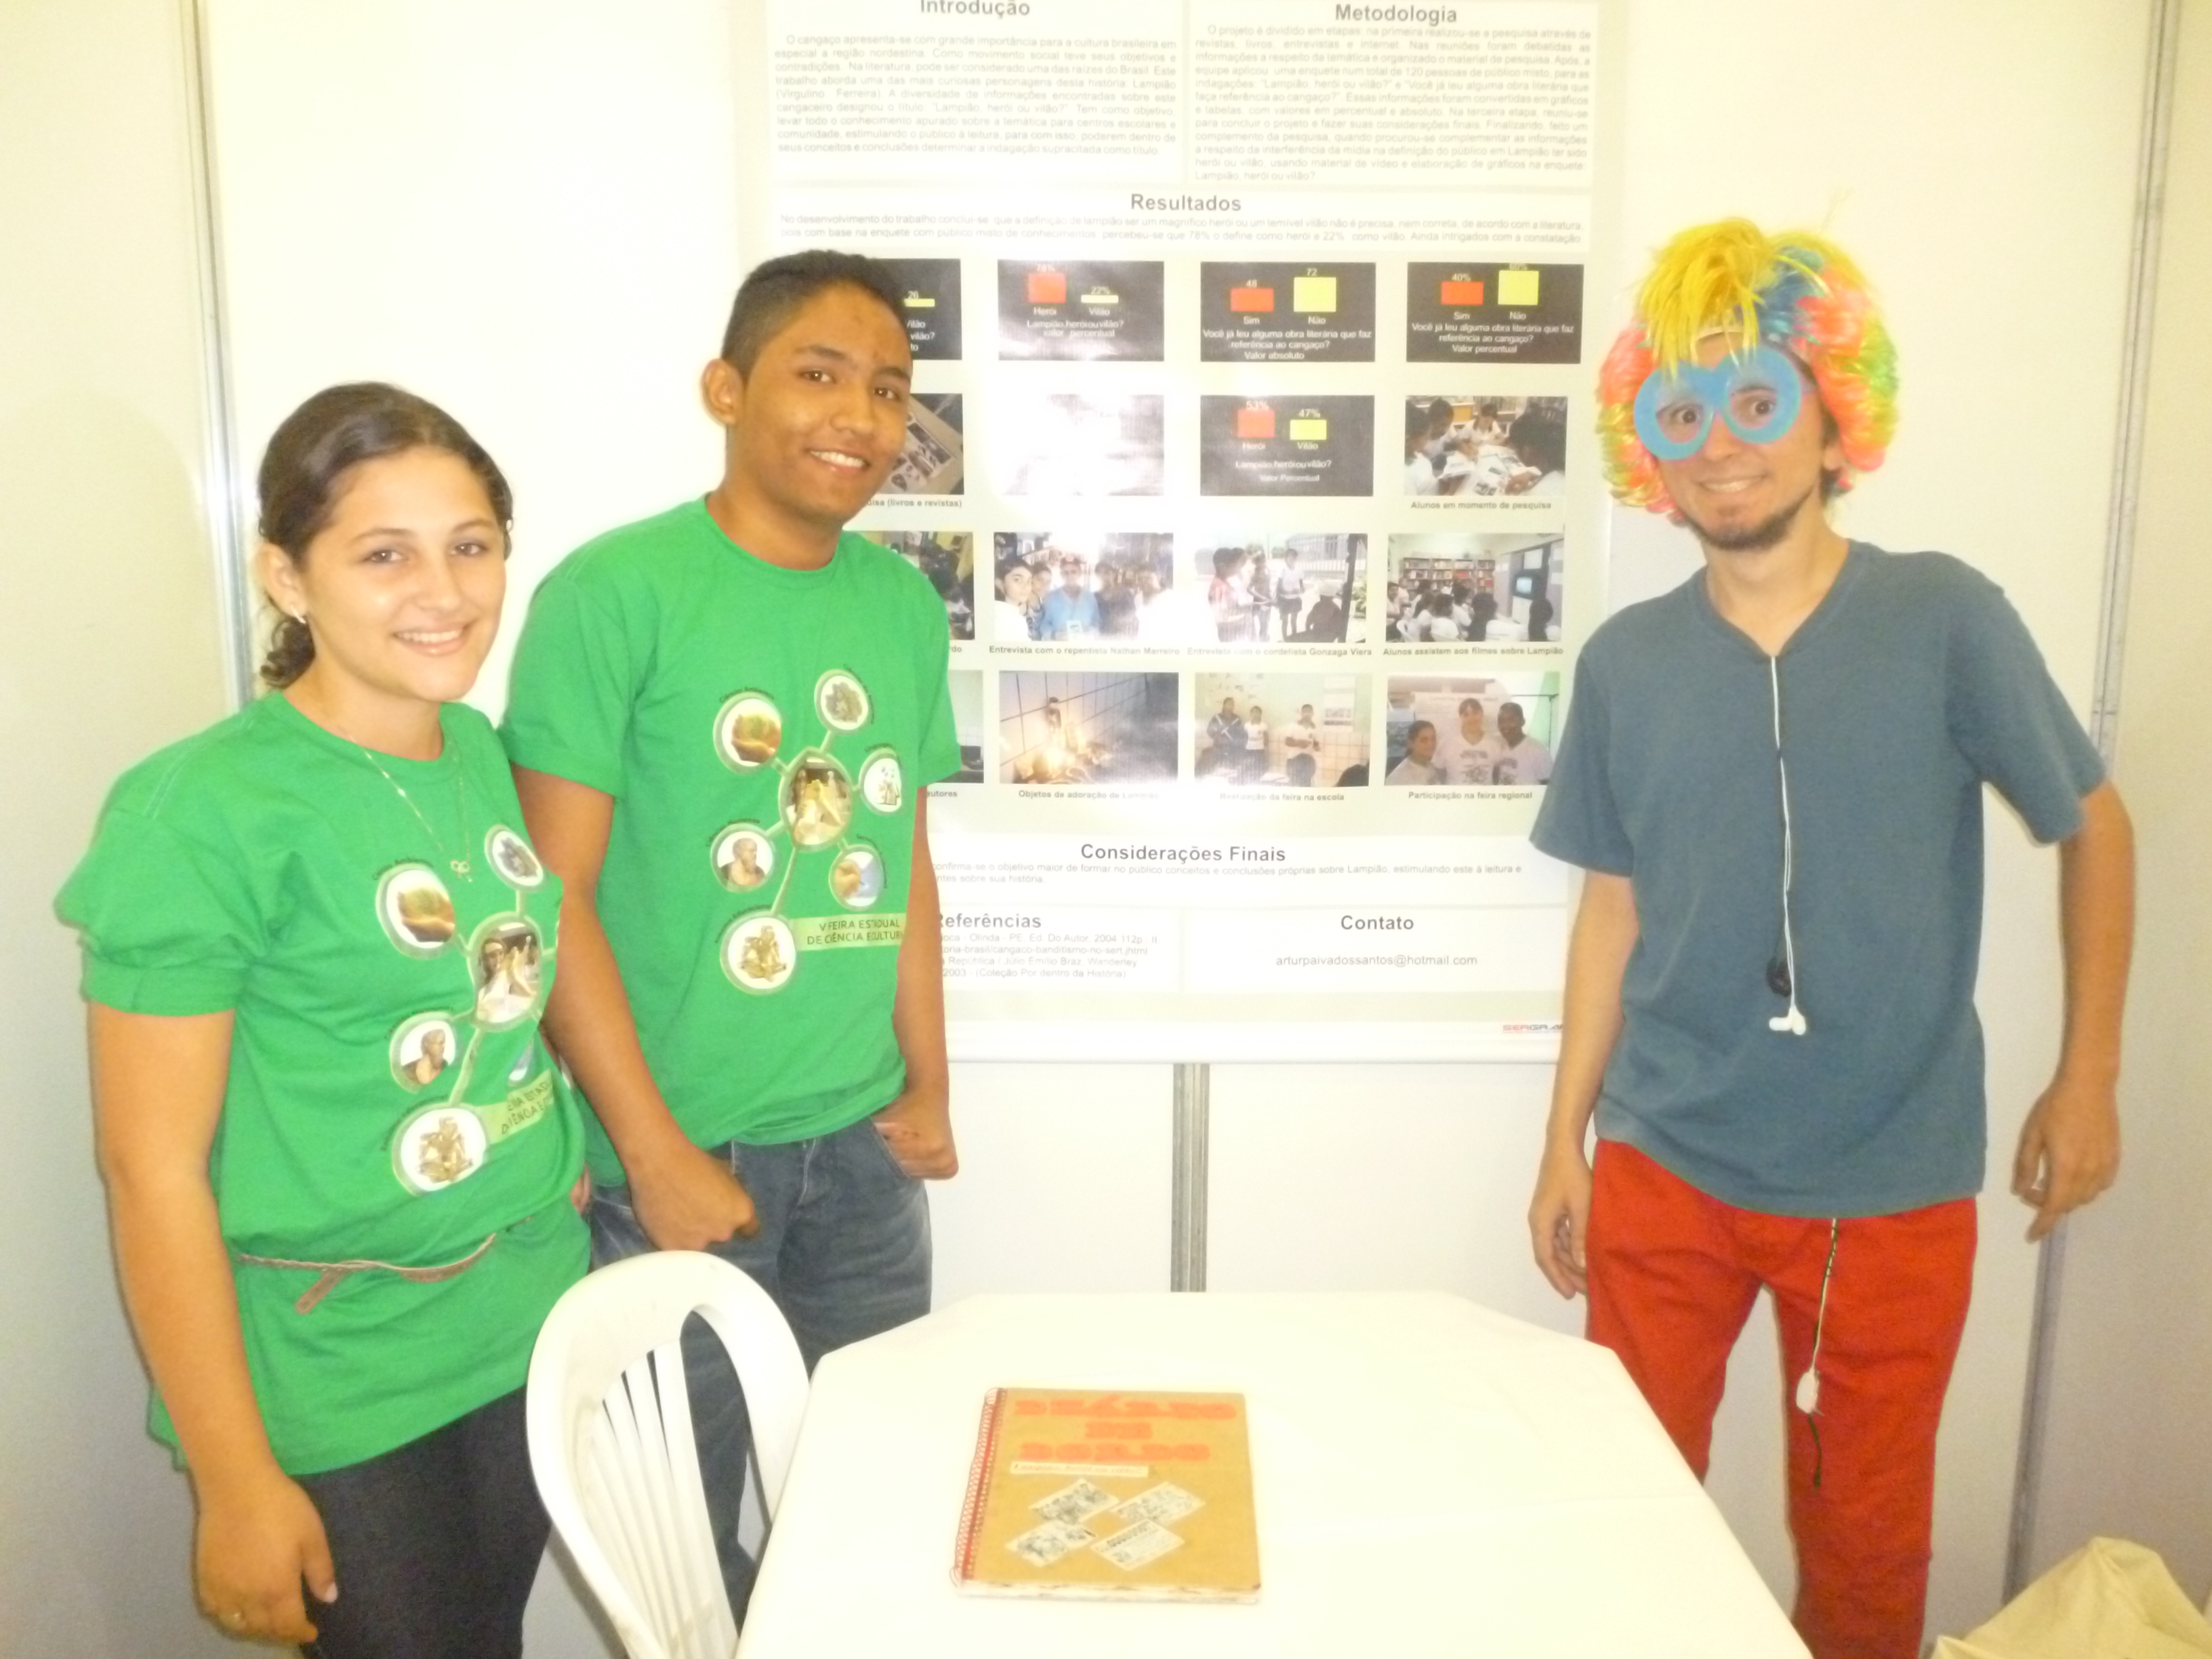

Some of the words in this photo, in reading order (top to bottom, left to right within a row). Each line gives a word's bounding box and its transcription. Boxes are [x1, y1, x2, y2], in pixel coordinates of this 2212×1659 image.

[920, 0, 1030, 19] Introdução
[1336, 4, 1457, 26] Metodologia
[1130, 193, 1242, 211] Resultados
[1243, 316, 1260, 325] Sim
[1308, 315, 1326, 325] Não
[1454, 311, 1470, 320] Sim
[1509, 311, 1526, 320] Não
[1412, 323, 1433, 331] Você
[1460, 324, 1490, 333] alguma
[1492, 324, 1510, 332] obra
[1544, 326, 1559, 334] que
[1203, 329, 1225, 338] Você
[1237, 329, 1249, 338] leu
[1252, 329, 1282, 340] alguma
[1285, 329, 1305, 338] obra
[1340, 331, 1356, 340] que
[1359, 329, 1372, 338] faz
[1245, 351, 1265, 359] Valor
[1268, 351, 1305, 359] absoluto
[1452, 345, 1473, 353] Valor
[1475, 345, 1517, 354] percentual
[1080, 843, 1223, 865] Considerações
[1230, 846, 1286, 862] Finais
[1340, 915, 1414, 930] Contato
[806, 935, 822, 945] DE
[1275, 954, 1477, 968] arturpaivadossantos@hotmail.com
